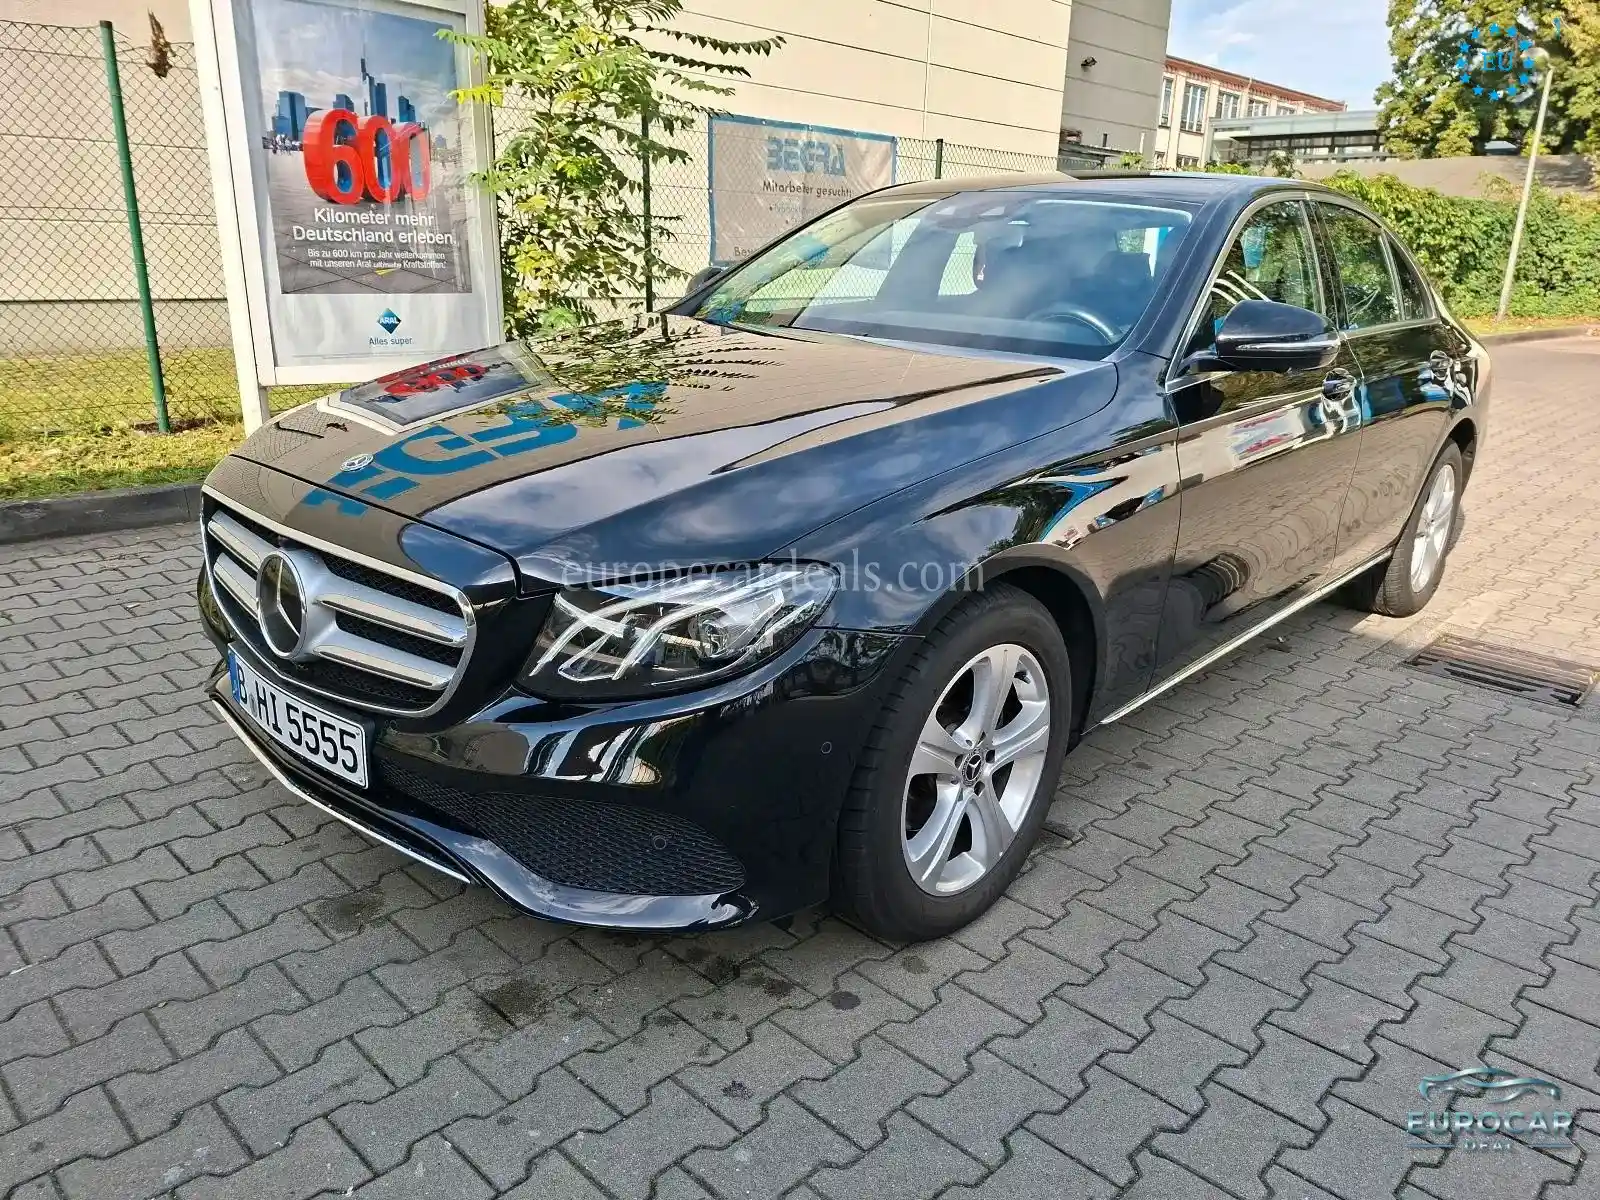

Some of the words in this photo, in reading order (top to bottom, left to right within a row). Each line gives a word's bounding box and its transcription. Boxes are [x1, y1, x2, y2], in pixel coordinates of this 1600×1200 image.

[303, 108, 432, 206] 600
[314, 207, 390, 225] Kilometer
[396, 212, 434, 226] mehr
[293, 226, 394, 243] Deutschland
[398, 229, 457, 245] erleben.
[308, 249, 320, 258] Bis
[321, 250, 331, 258] zu
[332, 250, 348, 258] 600
[350, 250, 362, 258] km
[364, 251, 376, 261] pro
[378, 250, 392, 259] Jahr
[394, 250, 446, 260] weiterkommen
[310, 259, 323, 267] mit
[324, 260, 355, 268] unseren
[356, 260, 371, 268] Aral
[369, 337, 389, 345] Alles
[236, 663, 248, 704] B
[254, 679, 283, 736] HI
[285, 701, 358, 774] 5555
